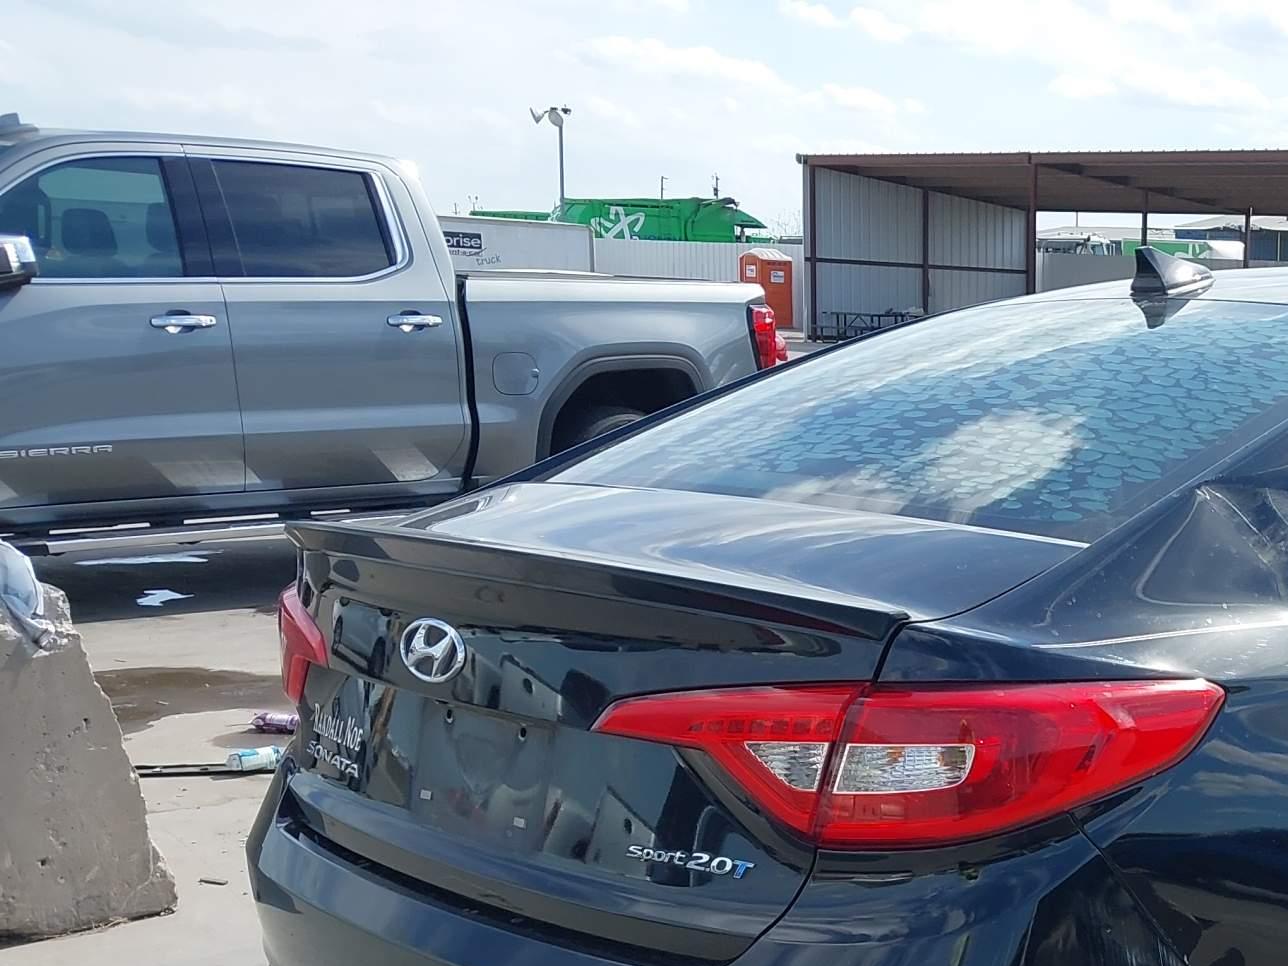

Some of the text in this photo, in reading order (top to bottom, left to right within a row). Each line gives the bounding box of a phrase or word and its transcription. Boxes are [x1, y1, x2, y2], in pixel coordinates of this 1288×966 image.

[0, 445, 113, 459] SIERRA
[306, 740, 359, 778] SONATA
[686, 852, 755, 879] 2.0T
